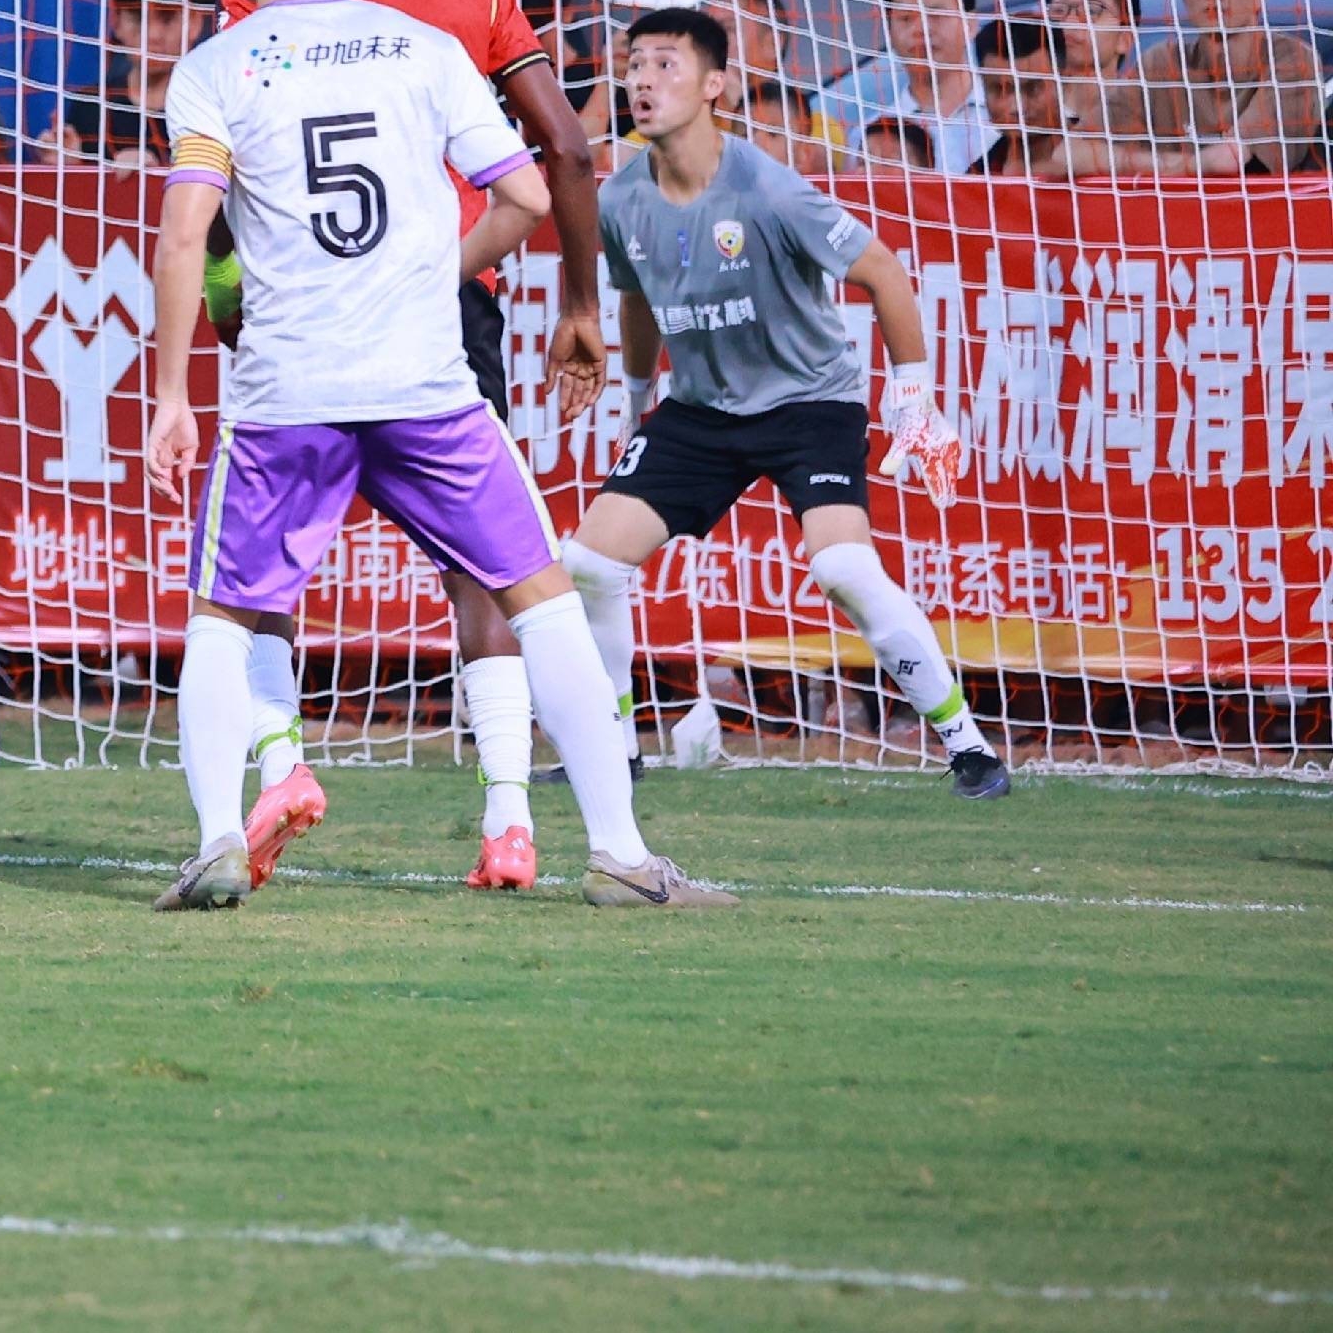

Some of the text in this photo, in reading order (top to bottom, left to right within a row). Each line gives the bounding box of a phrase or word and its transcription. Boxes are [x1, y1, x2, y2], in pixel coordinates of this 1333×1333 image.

[304, 35, 412, 67] 中旭未来
[301, 111, 388, 259] 5
[1155, 527, 1284, 623] 135
